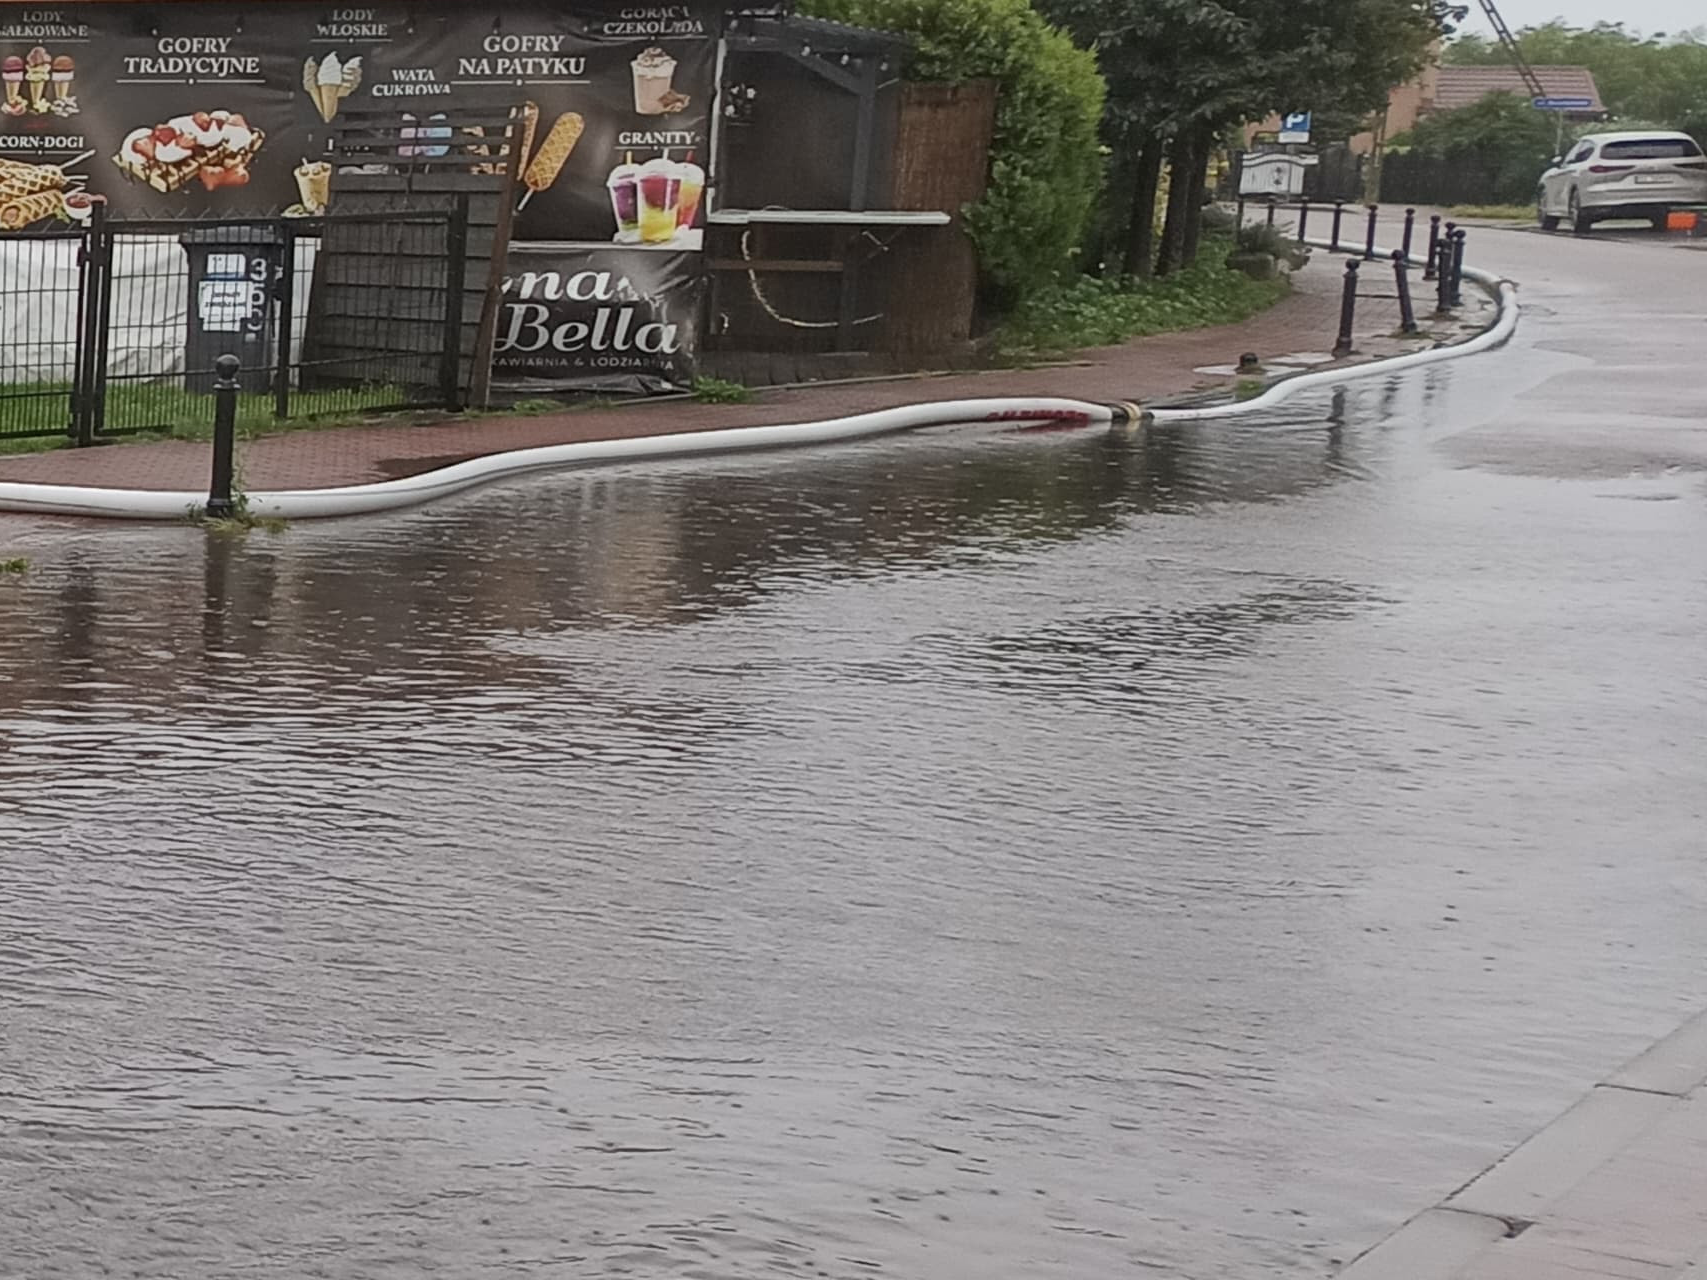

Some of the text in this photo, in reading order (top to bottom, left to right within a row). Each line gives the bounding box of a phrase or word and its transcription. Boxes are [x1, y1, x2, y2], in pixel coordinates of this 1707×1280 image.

[22, 10, 64, 22] LODY
[332, 8, 376, 21] LODY
[157, 37, 232, 53] GOFRY
[483, 35, 566, 53] GOFRY
[123, 57, 260, 77] TRADYCYJNE
[458, 56, 586, 75] NA PATYKU
[391, 69, 436, 81] WATA
[371, 83, 452, 97] CUKROWA
[618, 131, 695, 145] GRANITY
[494, 302, 681, 353] Bella
